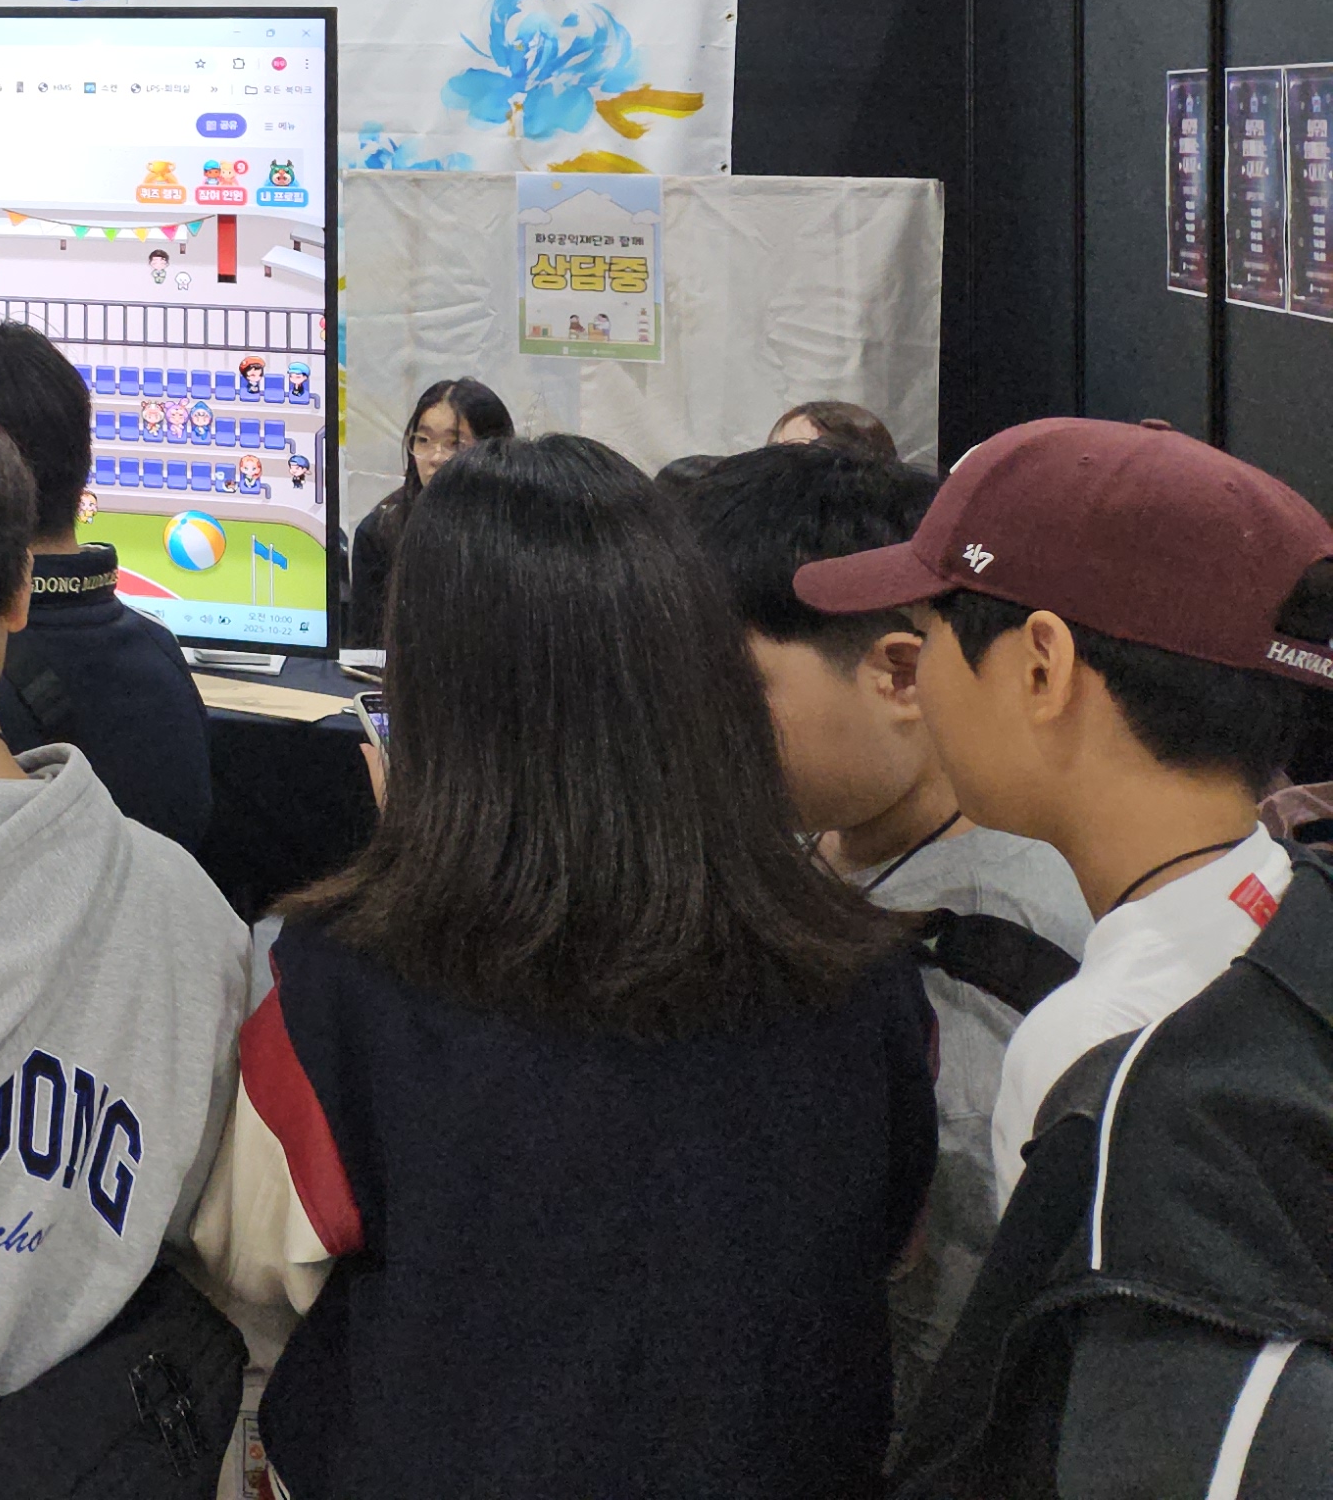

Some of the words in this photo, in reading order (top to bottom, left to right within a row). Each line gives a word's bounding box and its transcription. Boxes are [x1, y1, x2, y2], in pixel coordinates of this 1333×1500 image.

[220, 121, 238, 130] 공유
[278, 122, 295, 131] 메뉴
[238, 163, 245, 172] 9
[141, 188, 159, 199] 퀴즈
[223, 190, 243, 201] 인원
[260, 191, 271, 202] 내
[535, 233, 614, 247] 화우공익재단과
[531, 254, 649, 293] 상담중
[248, 613, 266, 622] 오전
[270, 615, 293, 624] 10:00
[243, 624, 292, 636] 2025-10-22
[1266, 640, 1333, 679] HARVAR
